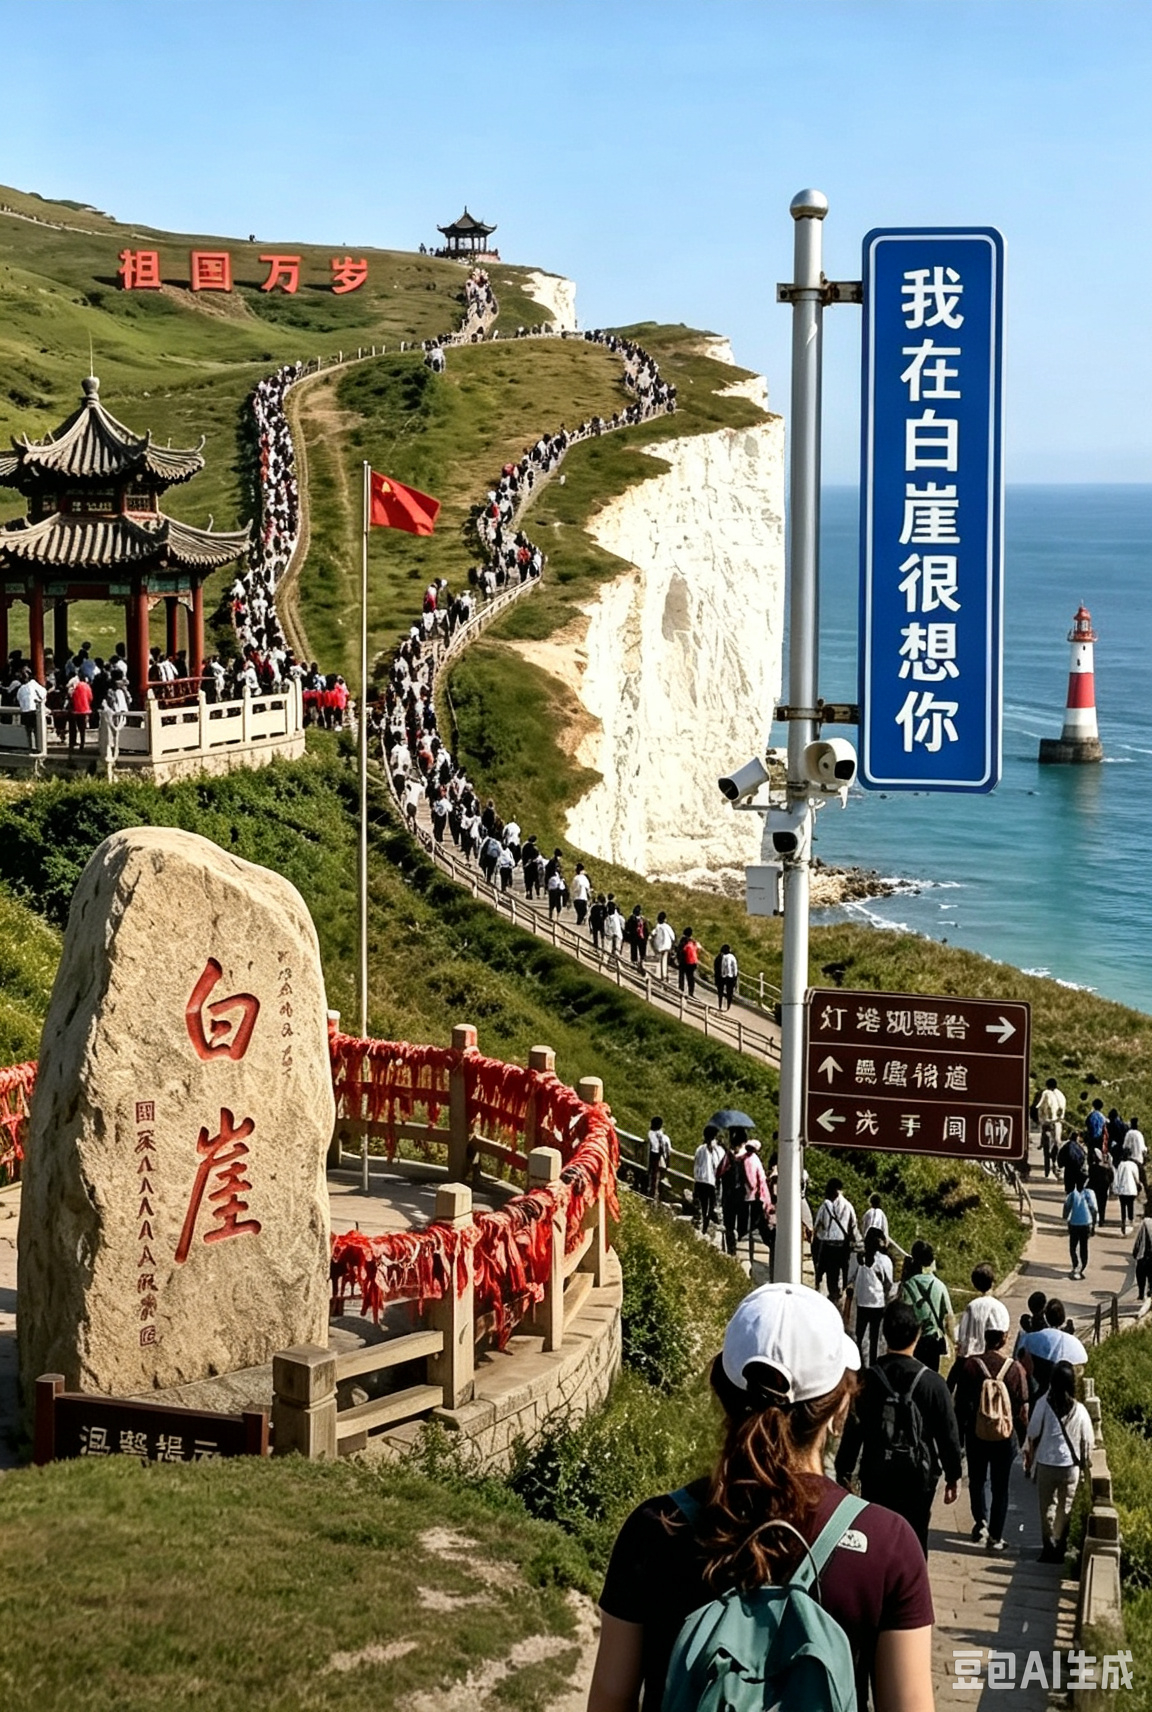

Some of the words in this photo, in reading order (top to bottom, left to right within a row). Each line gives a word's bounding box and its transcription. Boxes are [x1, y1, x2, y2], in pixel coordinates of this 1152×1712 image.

[119, 249, 369, 294] 祖国万岁
[895, 266, 965, 753] 我在白崖很想你
[174, 957, 262, 1265] 白崖
